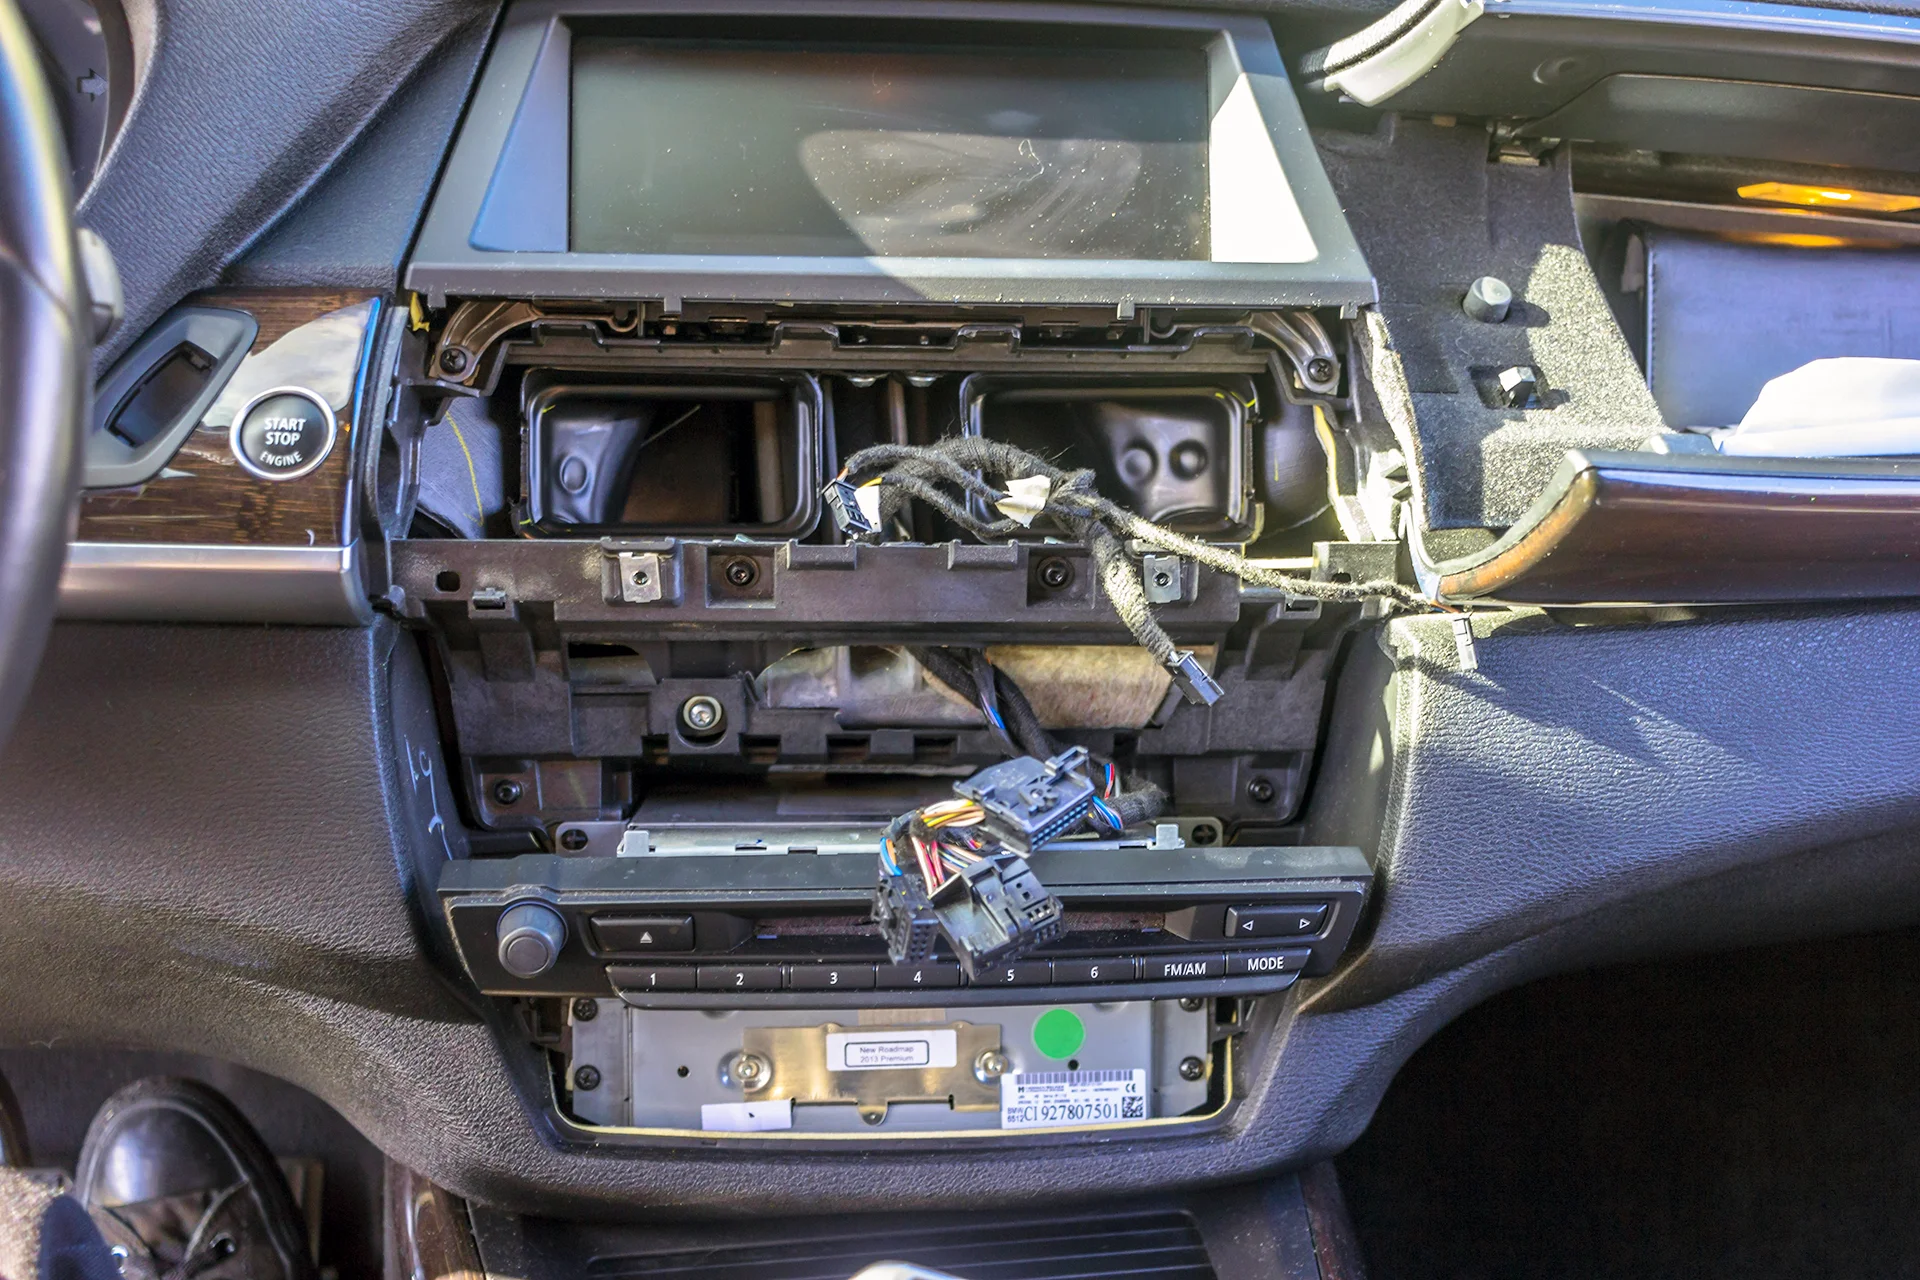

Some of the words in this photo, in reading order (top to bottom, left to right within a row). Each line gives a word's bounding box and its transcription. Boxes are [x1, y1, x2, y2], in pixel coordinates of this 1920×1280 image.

[263, 417, 307, 432] START
[265, 431, 302, 446] STOP
[259, 450, 304, 467] ENGINE
[650, 972, 656, 986] 1
[736, 972, 744, 986] 2
[829, 971, 838, 985] 3
[913, 970, 922, 983] 4
[1006, 968, 1015, 981] 5
[1090, 965, 1099, 979] 6
[1164, 961, 1207, 976] FM/AM
[1247, 956, 1284, 971] MODE
